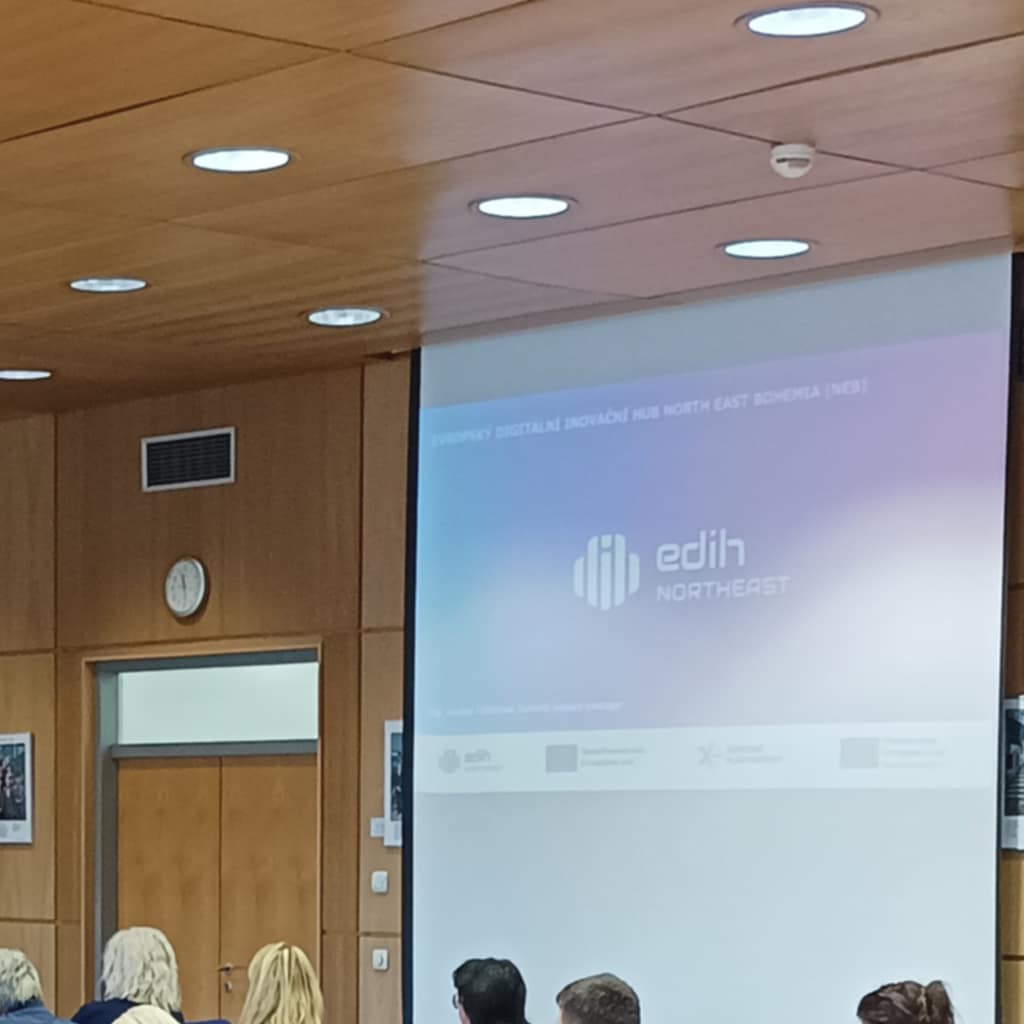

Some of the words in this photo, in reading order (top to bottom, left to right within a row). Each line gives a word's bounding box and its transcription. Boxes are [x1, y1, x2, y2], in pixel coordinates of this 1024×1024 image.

[496, 416, 560, 441] DIGITÁLNÍ
[564, 408, 628, 431] INOVAČNÍ
[632, 405, 659, 422] HUB
[663, 399, 710, 418] NORTH
[714, 393, 748, 412] EAST
[753, 386, 819, 408] BOHEMIA
[656, 528, 745, 572] edih
[656, 575, 792, 602] NORTHEAST
